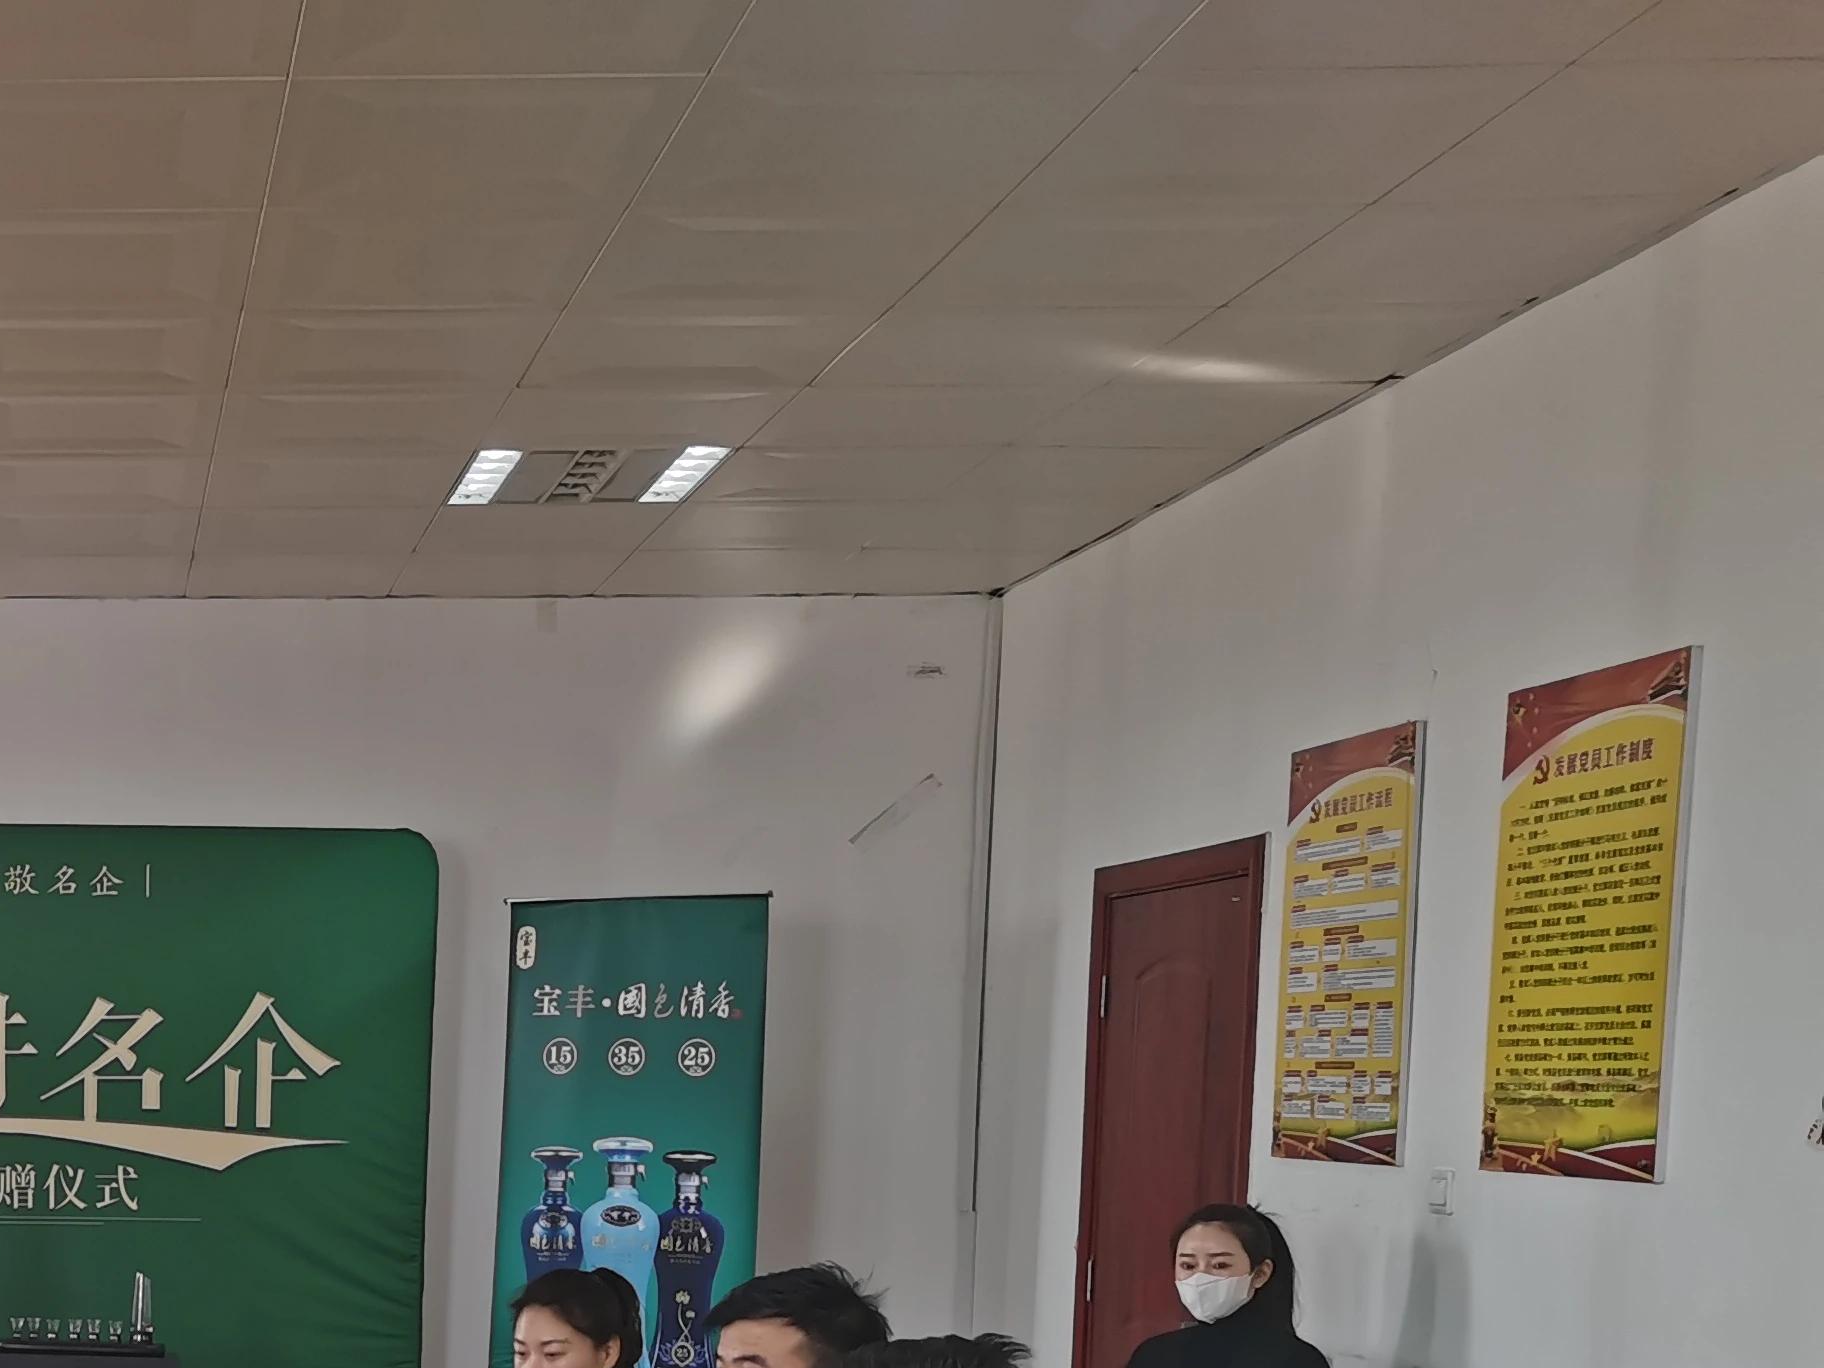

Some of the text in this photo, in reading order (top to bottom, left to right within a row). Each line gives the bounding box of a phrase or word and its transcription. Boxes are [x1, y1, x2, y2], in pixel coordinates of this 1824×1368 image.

[518, 929, 535, 967] 宝丰
[548, 1045, 572, 1065] 15
[612, 1045, 641, 1066] 35
[682, 1046, 710, 1066] 25
